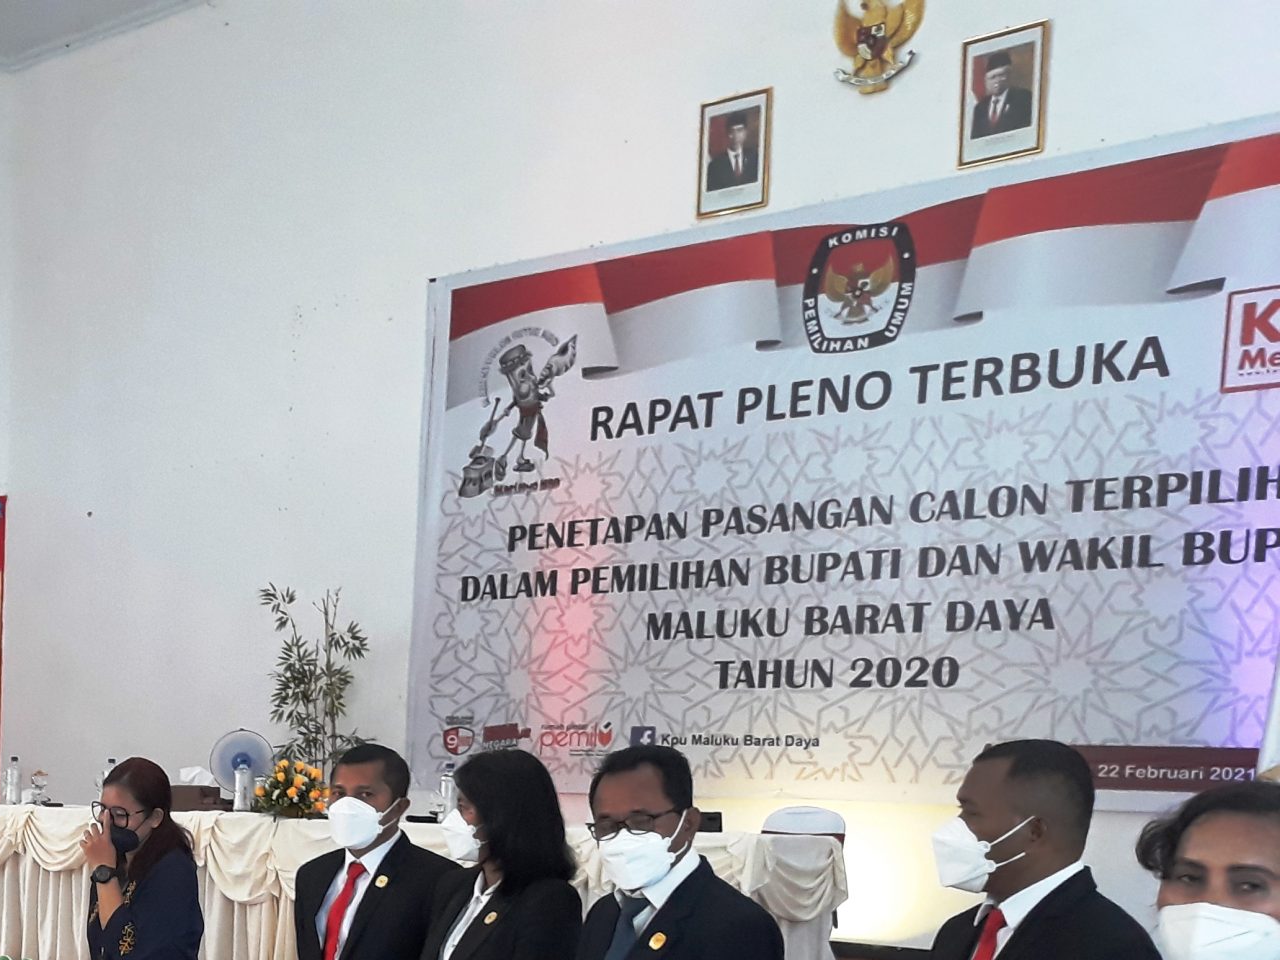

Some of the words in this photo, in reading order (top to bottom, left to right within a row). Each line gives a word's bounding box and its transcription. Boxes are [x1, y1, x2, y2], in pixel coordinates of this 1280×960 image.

[828, 226, 899, 248] KOMISI
[804, 297, 869, 350] PEMILIHAN
[883, 282, 913, 338] UMUM
[590, 391, 723, 441] RAPAT
[736, 370, 892, 424] PLENO
[910, 335, 1171, 403] TERBUKA
[507, 511, 688, 553] PENETAPAN
[701, 495, 893, 538] PASANGAN
[909, 482, 1048, 524] CALON
[1065, 465, 1280, 514] TERPILIH
[460, 569, 558, 602] DALAM
[570, 558, 751, 596] PEMILIHAN
[764, 548, 902, 586] BUPATI
[917, 542, 1002, 580] DAN
[1019, 533, 1164, 574] WAKIL
[646, 607, 790, 642] MALUKU
[804, 602, 932, 637] BARAT
[945, 597, 1056, 633] DAYA
[713, 658, 834, 690] TAHUN
[848, 656, 960, 689] 2020
[661, 735, 687, 747] Kpu
[691, 734, 739, 747] Maluku
[743, 735, 781, 747] Barat
[784, 735, 820, 750] Daya
[1098, 764, 1119, 778] 22
[1125, 764, 1204, 780] Februari
[1210, 767, 1256, 781] 2021
